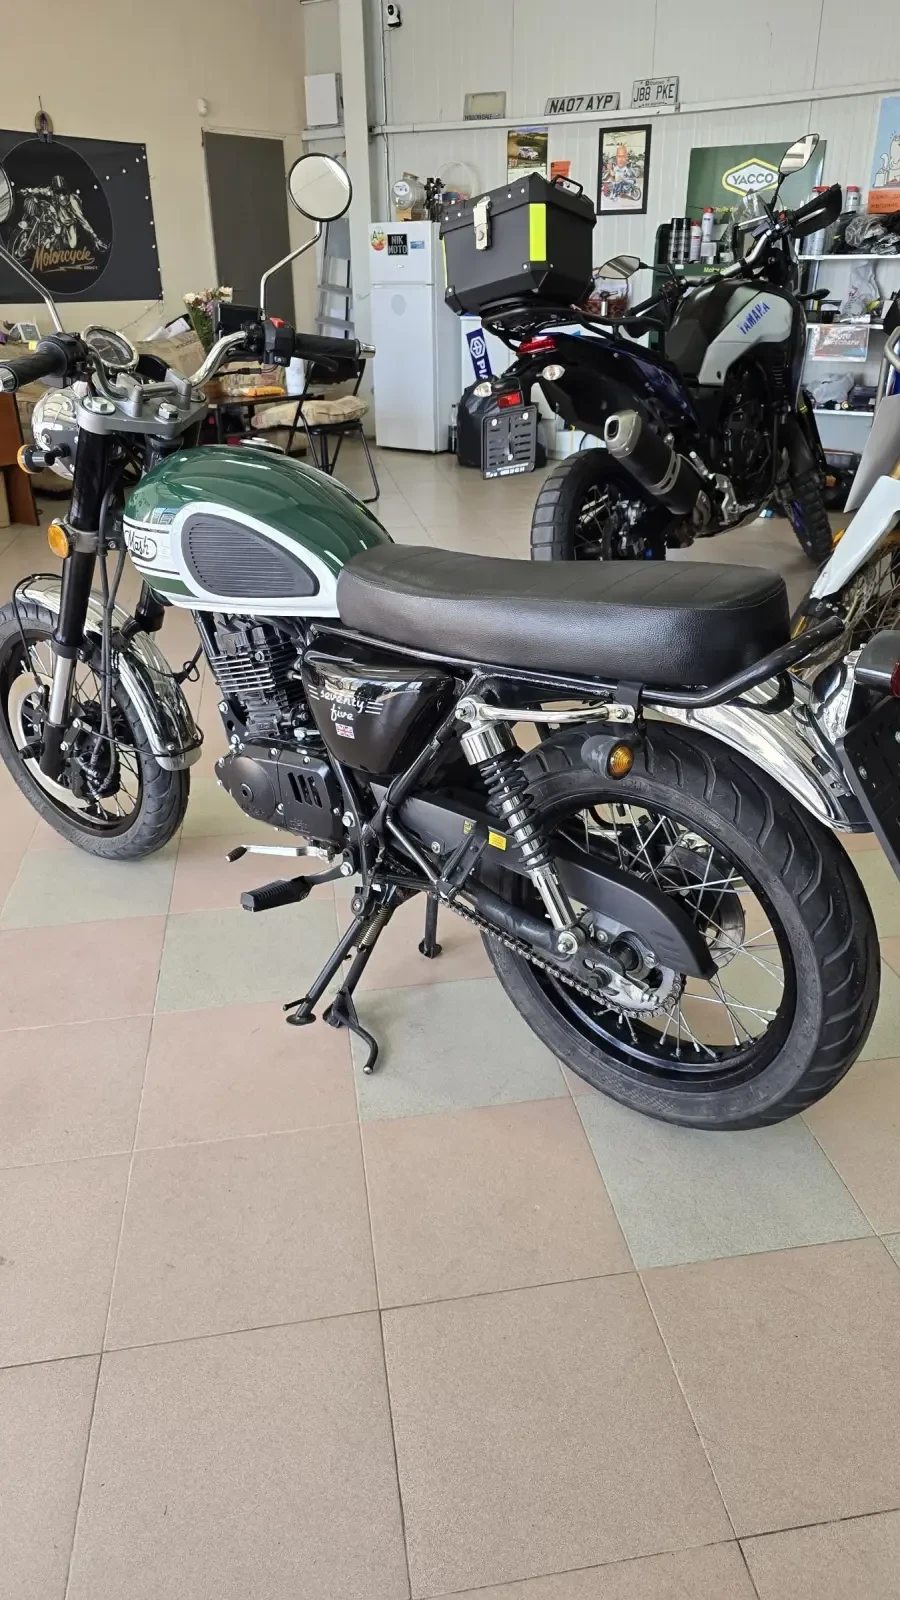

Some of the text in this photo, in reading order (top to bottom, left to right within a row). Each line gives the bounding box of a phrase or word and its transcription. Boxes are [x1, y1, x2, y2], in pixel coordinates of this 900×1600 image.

[633, 83, 675, 102] J88 PKE
[586, 95, 614, 111] AYP
[732, 173, 774, 185] YACCO
[388, 245, 408, 254] MOTO
[391, 235, 404, 245] NIK
[30, 246, 92, 272] Motorcycle
[126, 529, 150, 556] Mash
[320, 689, 365, 714] seventy
[330, 703, 354, 722] five
